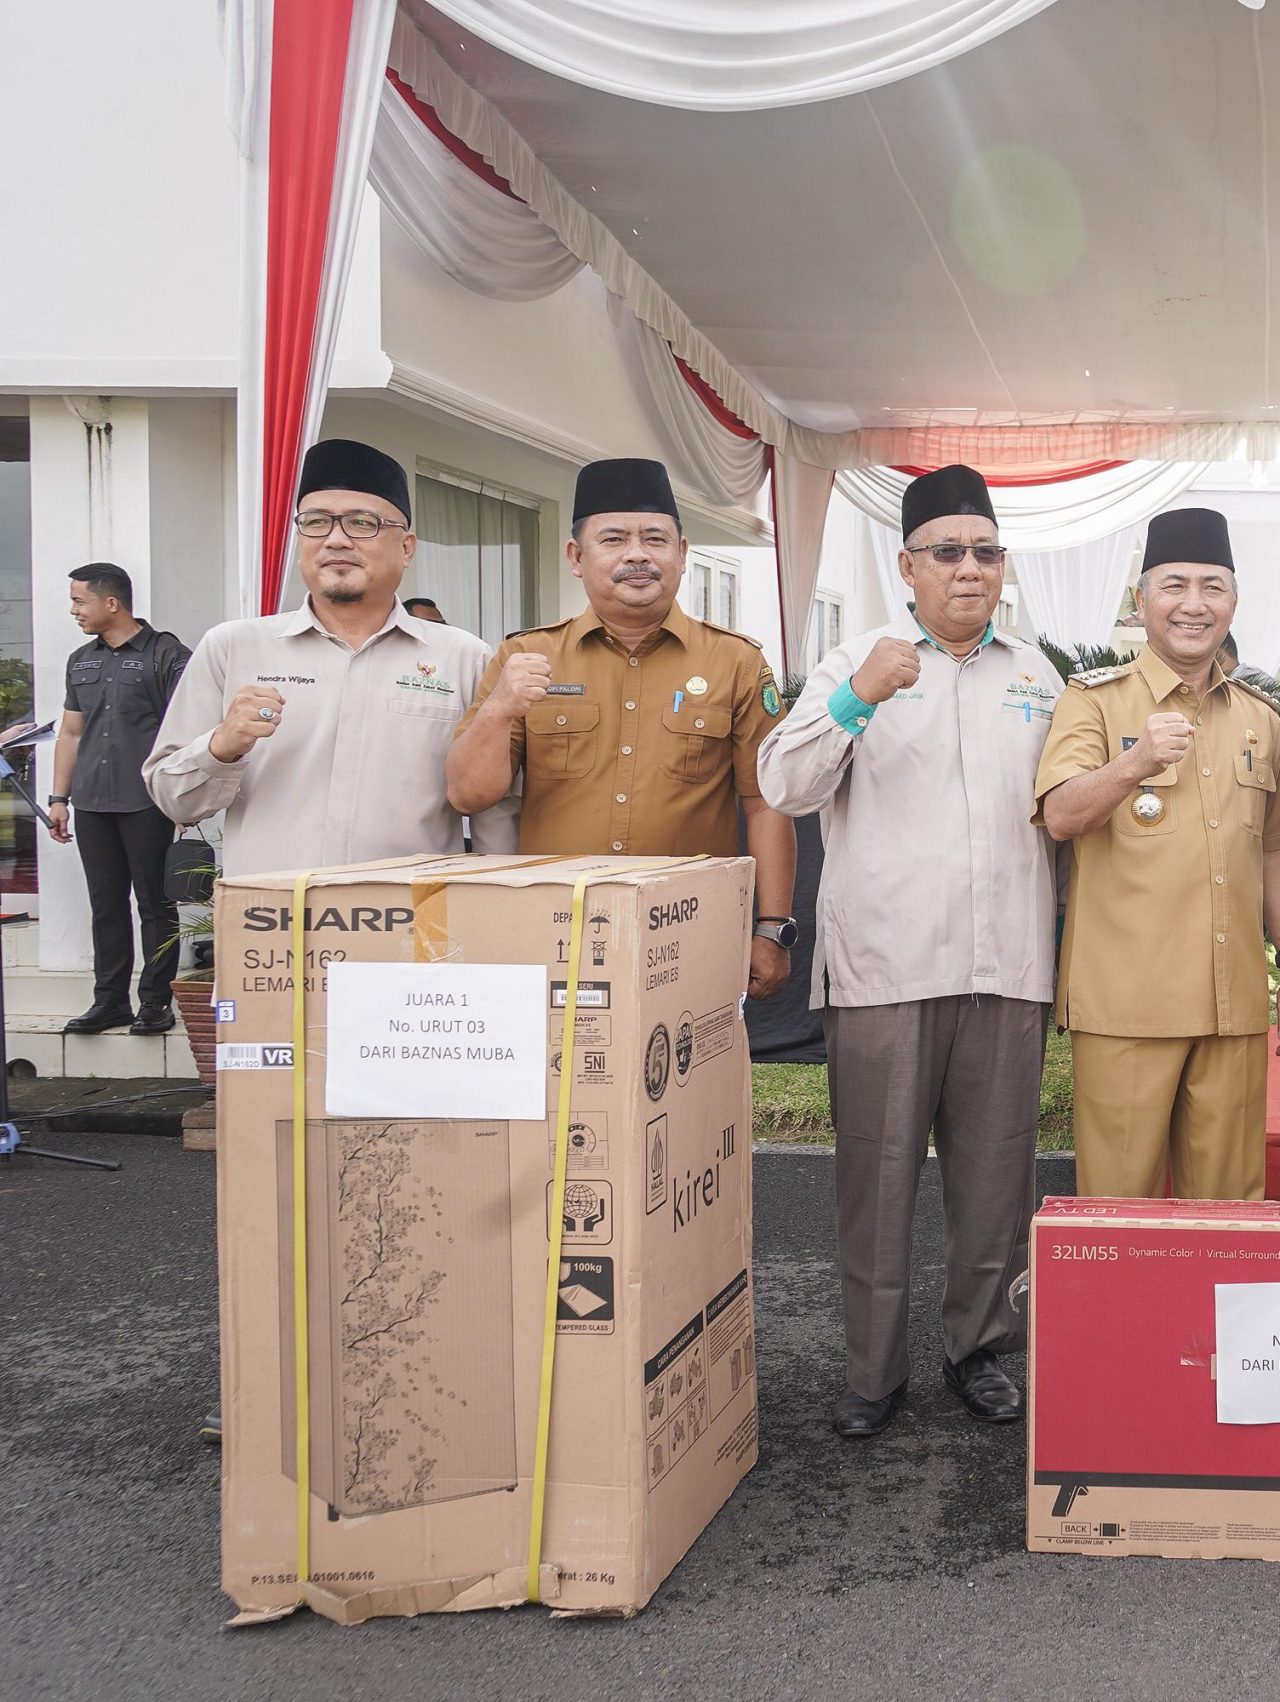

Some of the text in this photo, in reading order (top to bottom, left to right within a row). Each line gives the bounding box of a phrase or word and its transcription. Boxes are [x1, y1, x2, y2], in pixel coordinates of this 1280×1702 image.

[257, 675, 316, 685] Hendra Wijaya
[401, 675, 450, 689] BAZNAS
[242, 906, 415, 932] SHARP
[553, 912, 573, 924] DEPA
[649, 897, 699, 930] SHARP
[646, 941, 680, 968] SJ-N162
[242, 976, 316, 992] LEMARI
[646, 966, 679, 991] LEMARI ES
[405, 993, 469, 1007] JUARA 1
[389, 1019, 486, 1034] No. URUT 03
[264, 1048, 295, 1065] VR
[360, 1045, 516, 1061] DARI BAZNAS MUBA
[584, 1055, 606, 1070] SNI
[673, 1148, 720, 1234] kirei
[1051, 1244, 1119, 1261] 32LM55
[1128, 1247, 1167, 1259] Dynamic
[1169, 1248, 1195, 1258] Color
[1206, 1249, 1237, 1259] Virtual
[1239, 1250, 1280, 1260] Surround
[573, 1262, 603, 1275] 100kg
[588, 1324, 609, 1332] GLASS
[1241, 1358, 1275, 1372] DARI
[1064, 1524, 1088, 1534] BACK
[586, 1572, 598, 1582] 26
[600, 1573, 616, 1585] Kg
